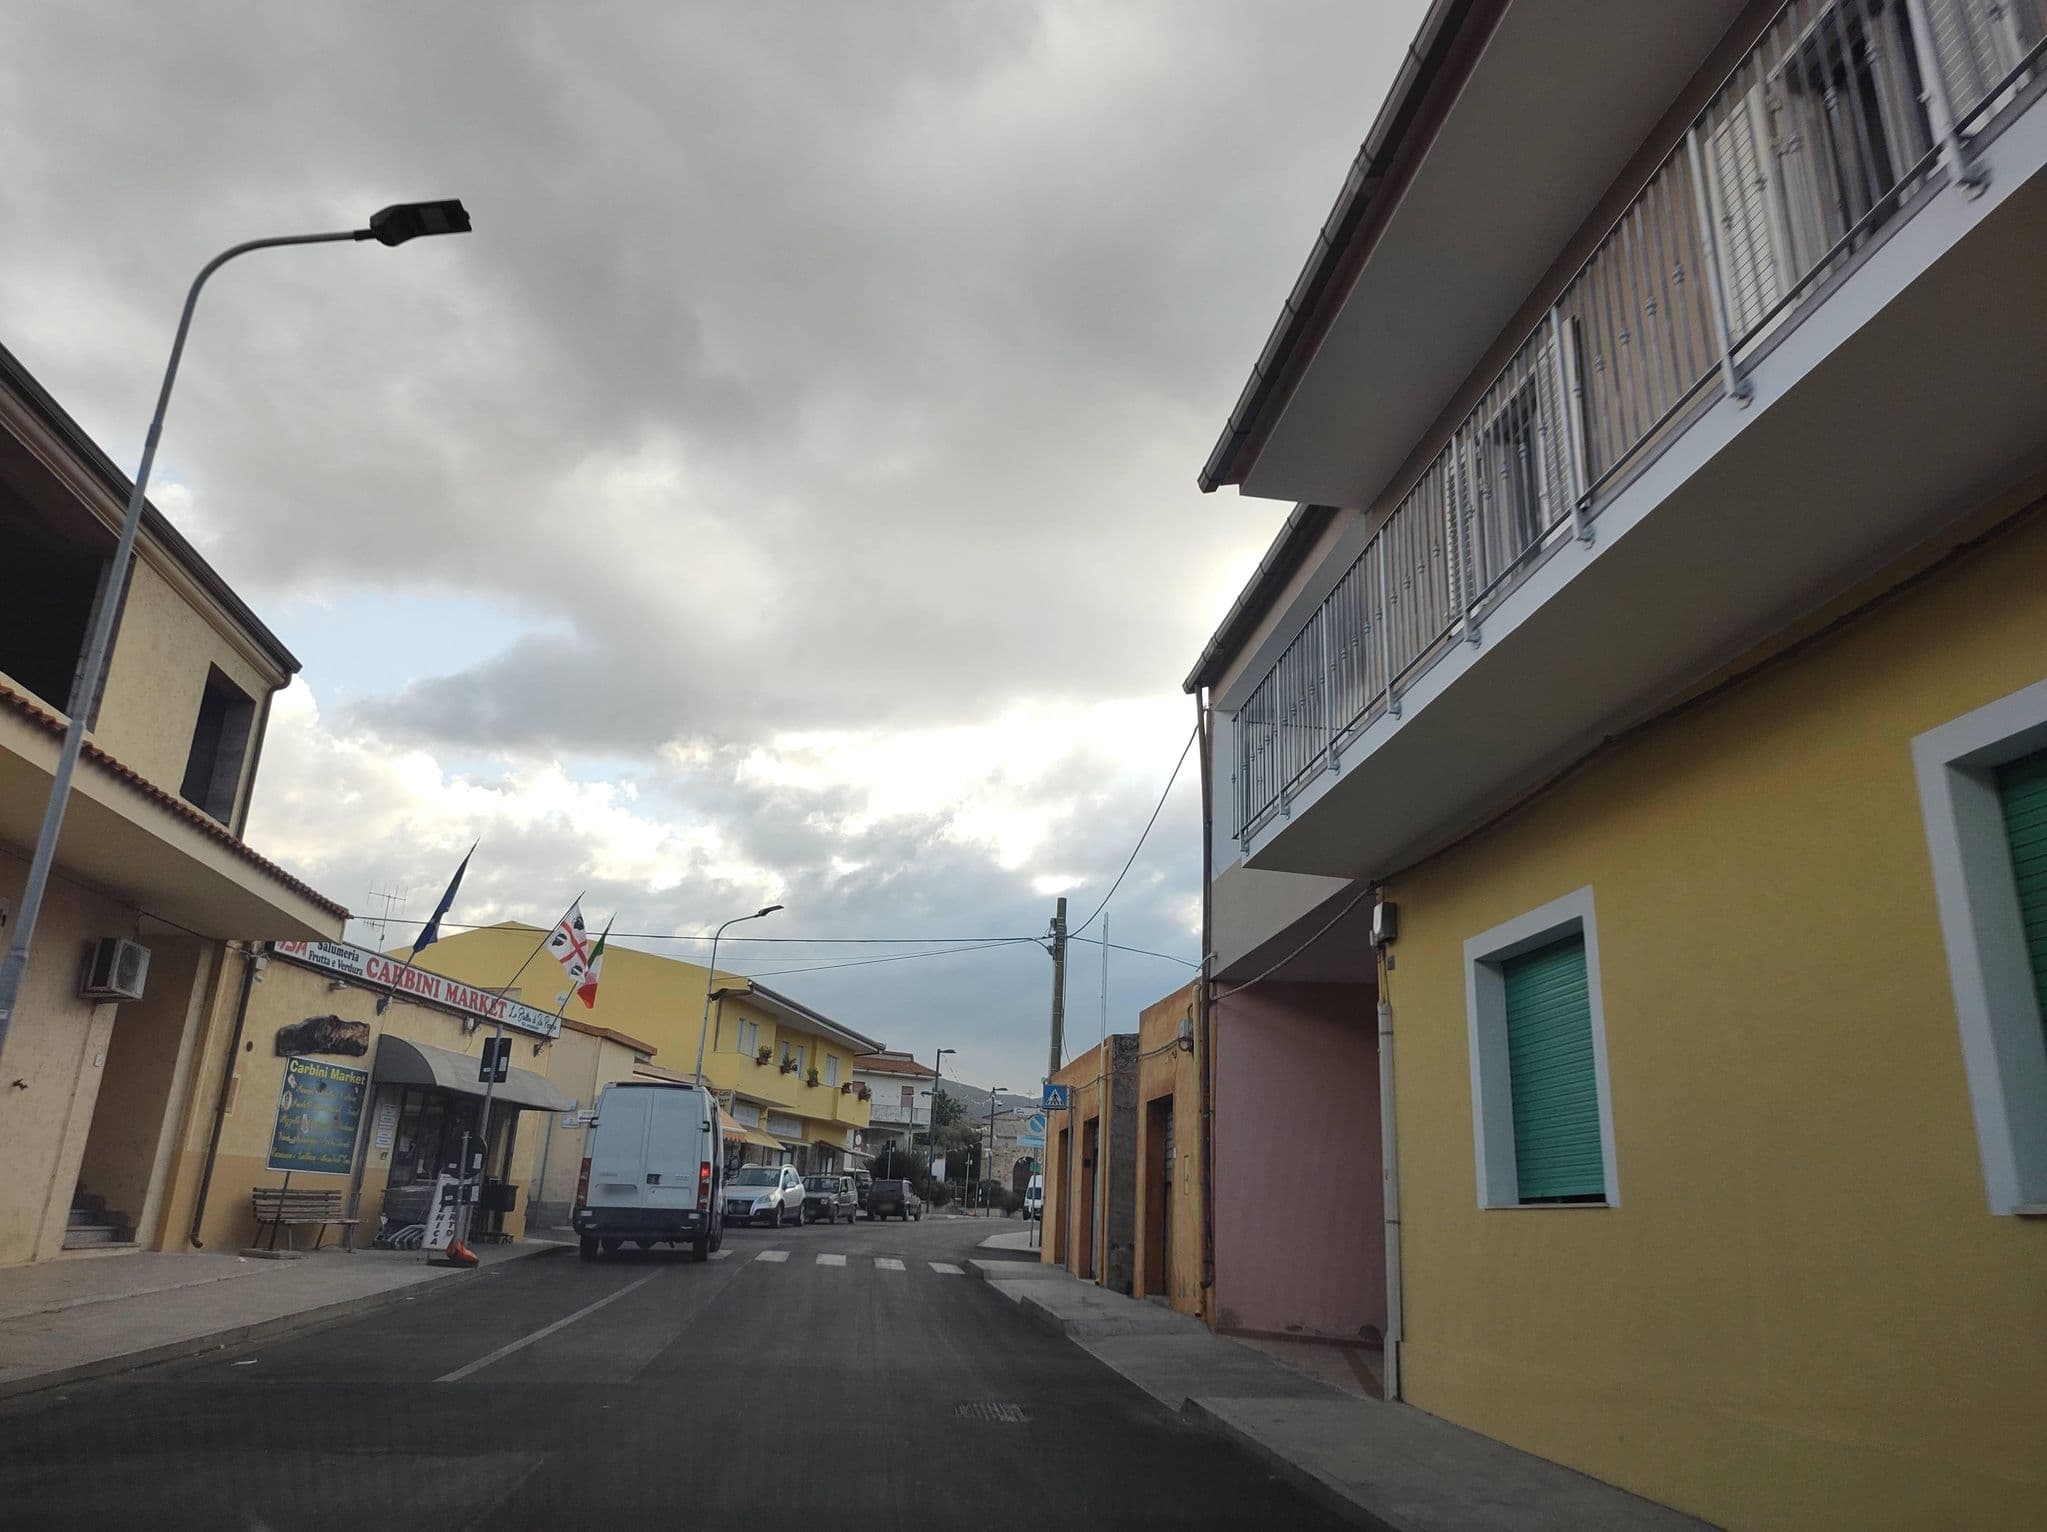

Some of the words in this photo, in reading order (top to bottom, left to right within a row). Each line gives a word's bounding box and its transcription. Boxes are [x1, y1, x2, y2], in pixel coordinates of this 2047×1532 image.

[308, 950, 331, 966] Frutta
[337, 959, 364, 976] Verdura
[317, 942, 361, 963] Salumeria
[366, 957, 441, 999] CARBINI
[445, 982, 508, 1019] MARKET
[289, 1059, 329, 1078] Carbini
[330, 1068, 366, 1086] Market
